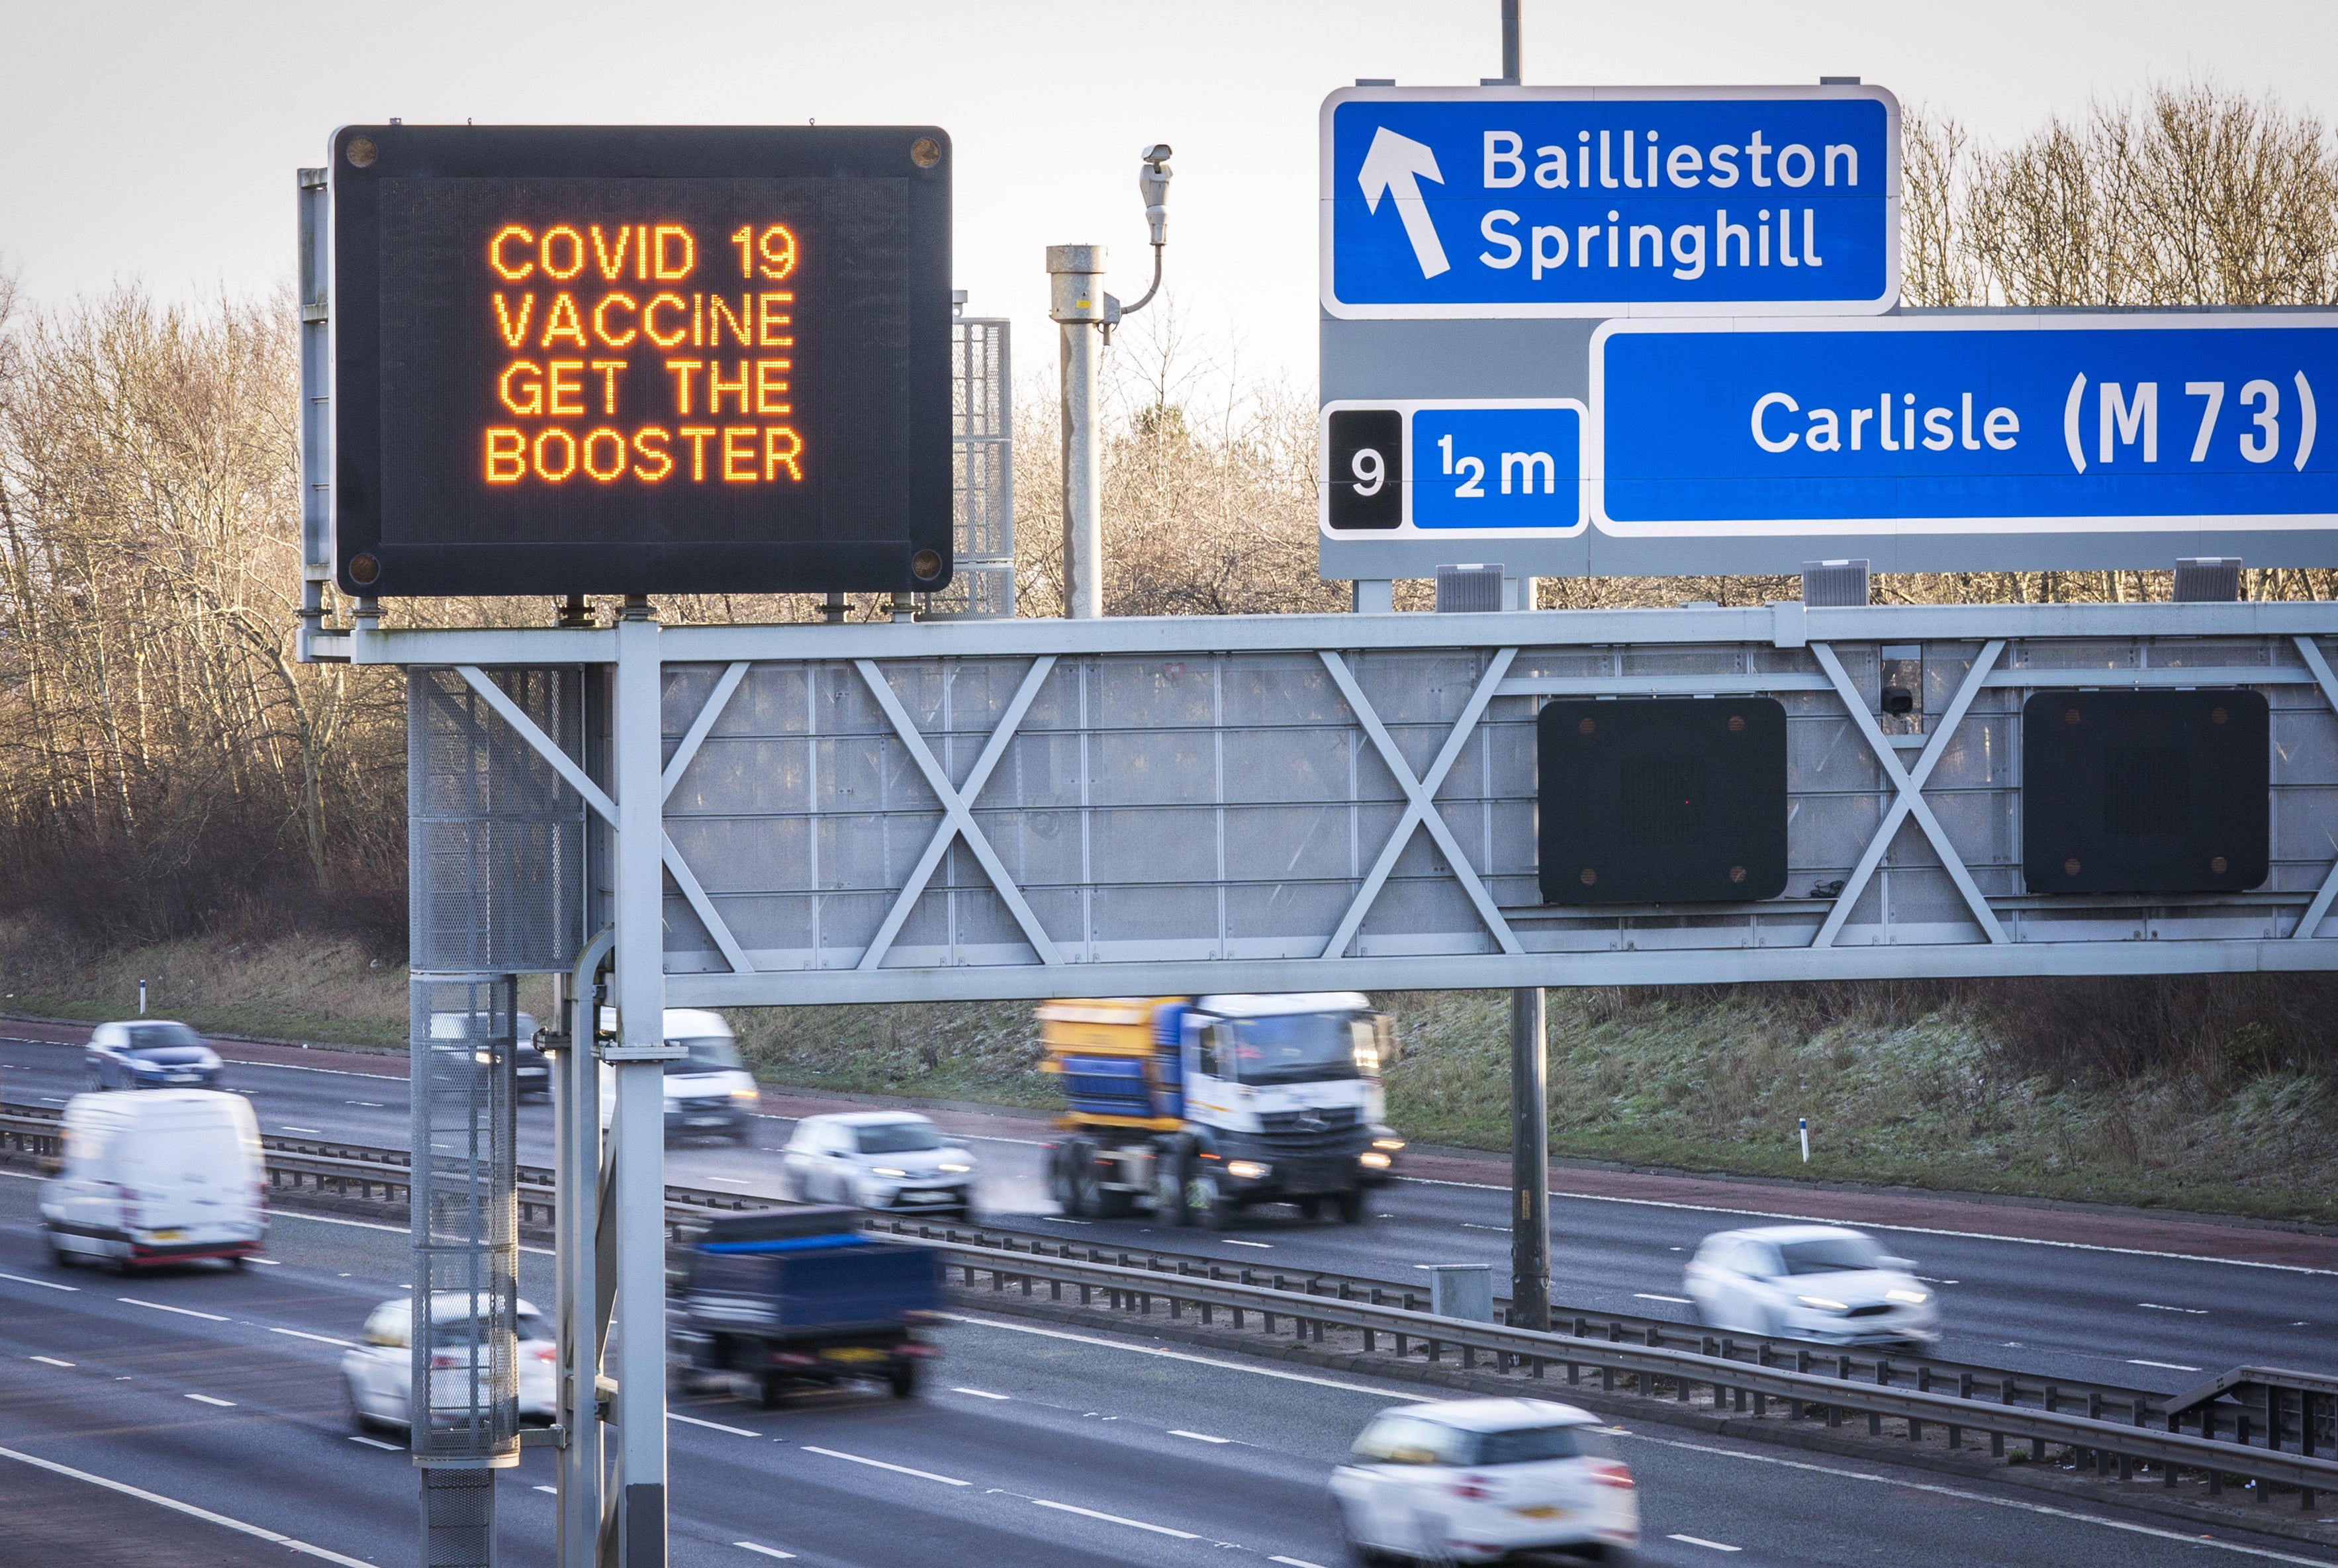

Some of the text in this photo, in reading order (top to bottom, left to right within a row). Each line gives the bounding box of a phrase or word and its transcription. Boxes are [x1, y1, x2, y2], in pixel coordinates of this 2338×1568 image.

[1483, 130, 1857, 189] Baillieston
[489, 225, 797, 281] COVID 19
[1479, 208, 1822, 281] Springhill
[492, 293, 794, 348] VACCINE
[498, 359, 792, 416] GET THE
[1751, 392, 2020, 453] Carlisle
[485, 426, 803, 483] BOOSTER
[1352, 448, 1385, 496] 9
[1501, 451, 1555, 494] m
